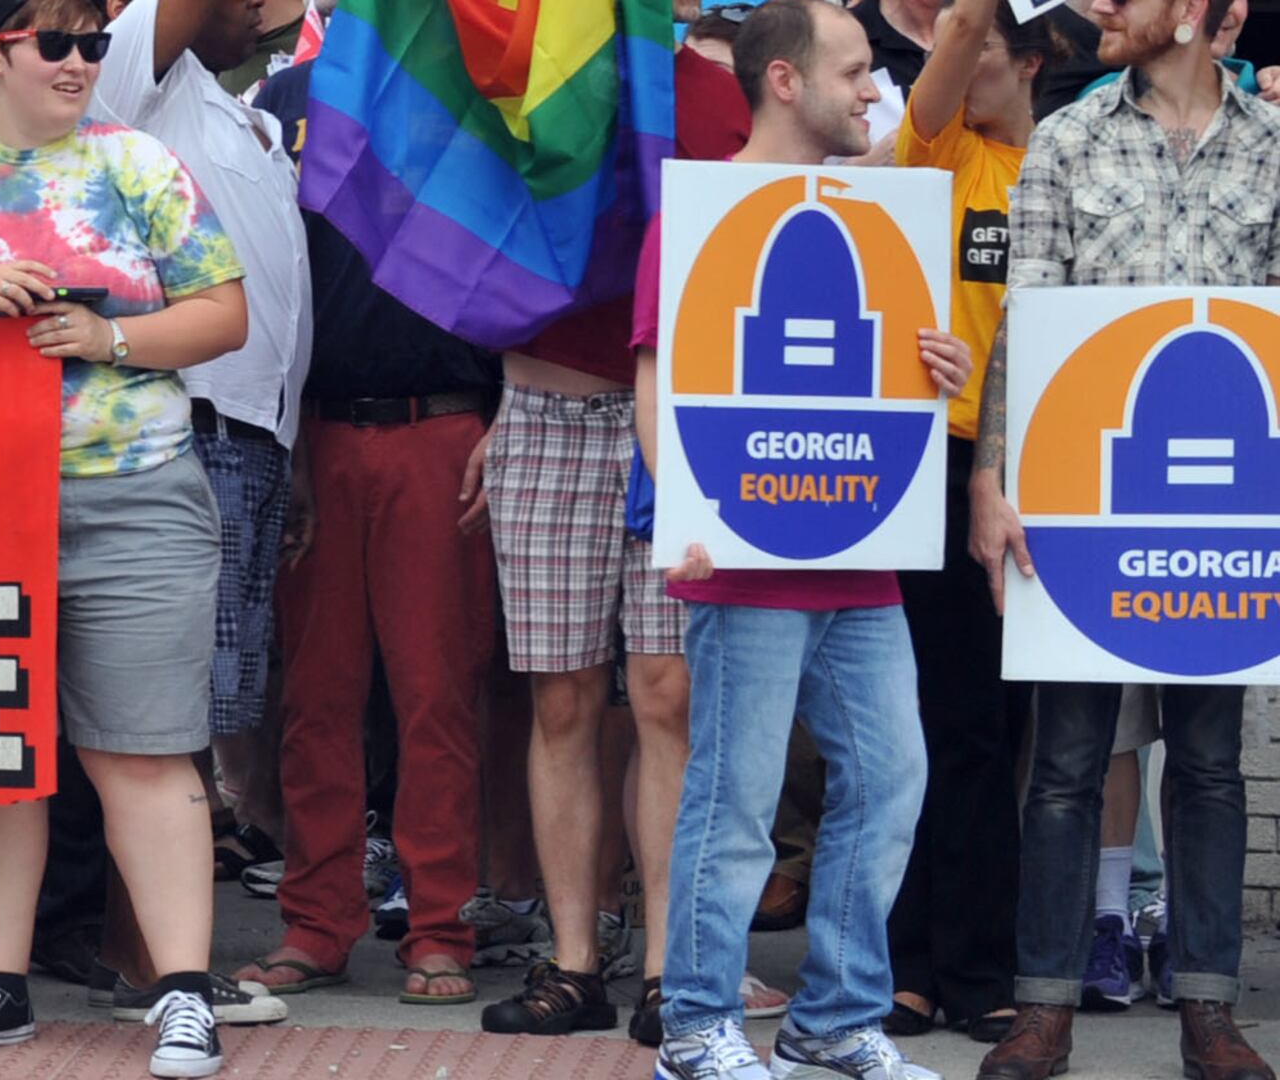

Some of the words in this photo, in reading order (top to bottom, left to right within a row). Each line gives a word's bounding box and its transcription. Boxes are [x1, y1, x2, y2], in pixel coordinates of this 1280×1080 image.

[971, 226, 1009, 243] GET
[966, 248, 1004, 265] GET
[747, 430, 874, 462] GEORGIA
[740, 473, 879, 506] EQUALITY
